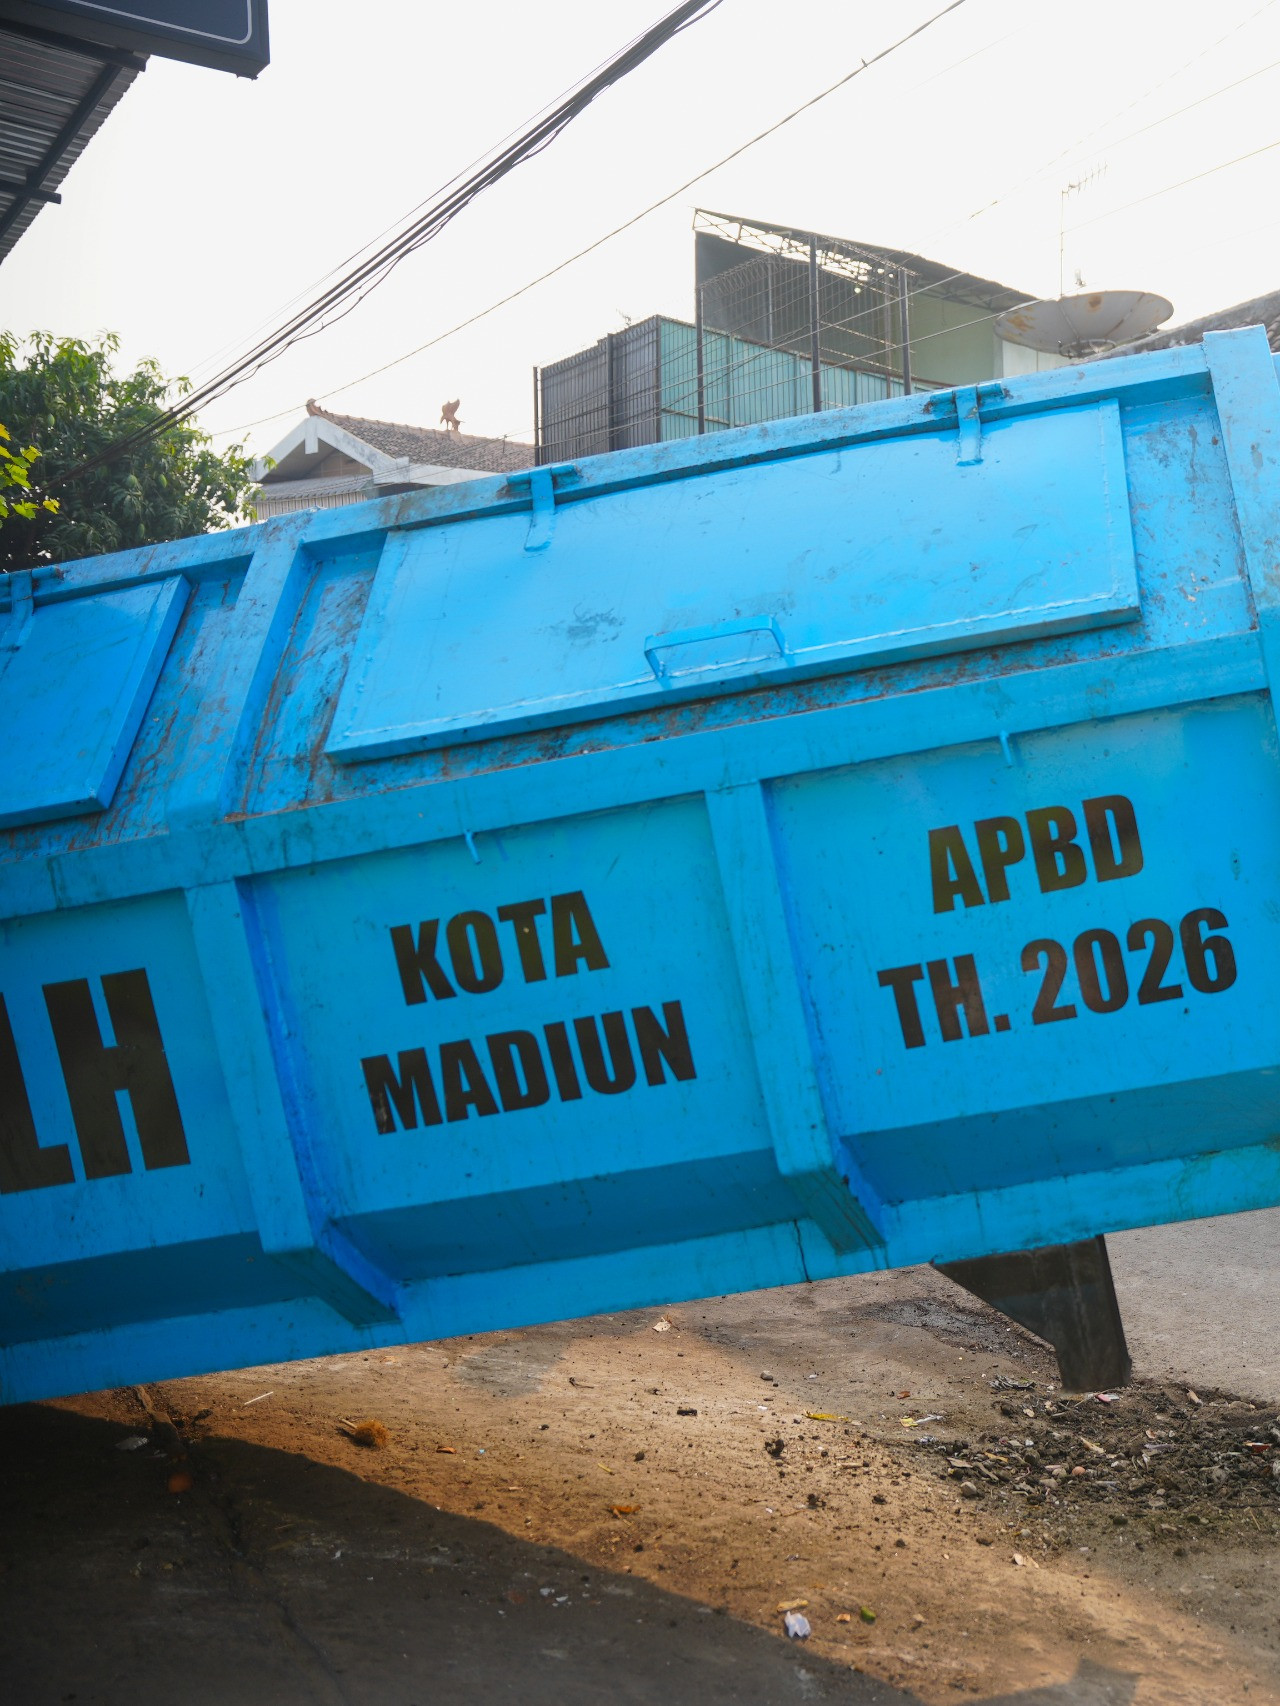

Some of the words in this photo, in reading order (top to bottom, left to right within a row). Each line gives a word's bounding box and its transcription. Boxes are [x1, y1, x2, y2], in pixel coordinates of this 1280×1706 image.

[928, 794, 1144, 914] APBD
[389, 890, 611, 1006] KOTA
[876, 953, 1011, 1050] TH.
[1020, 907, 1237, 1026] 2026
[361, 1000, 697, 1136] MADIUN
